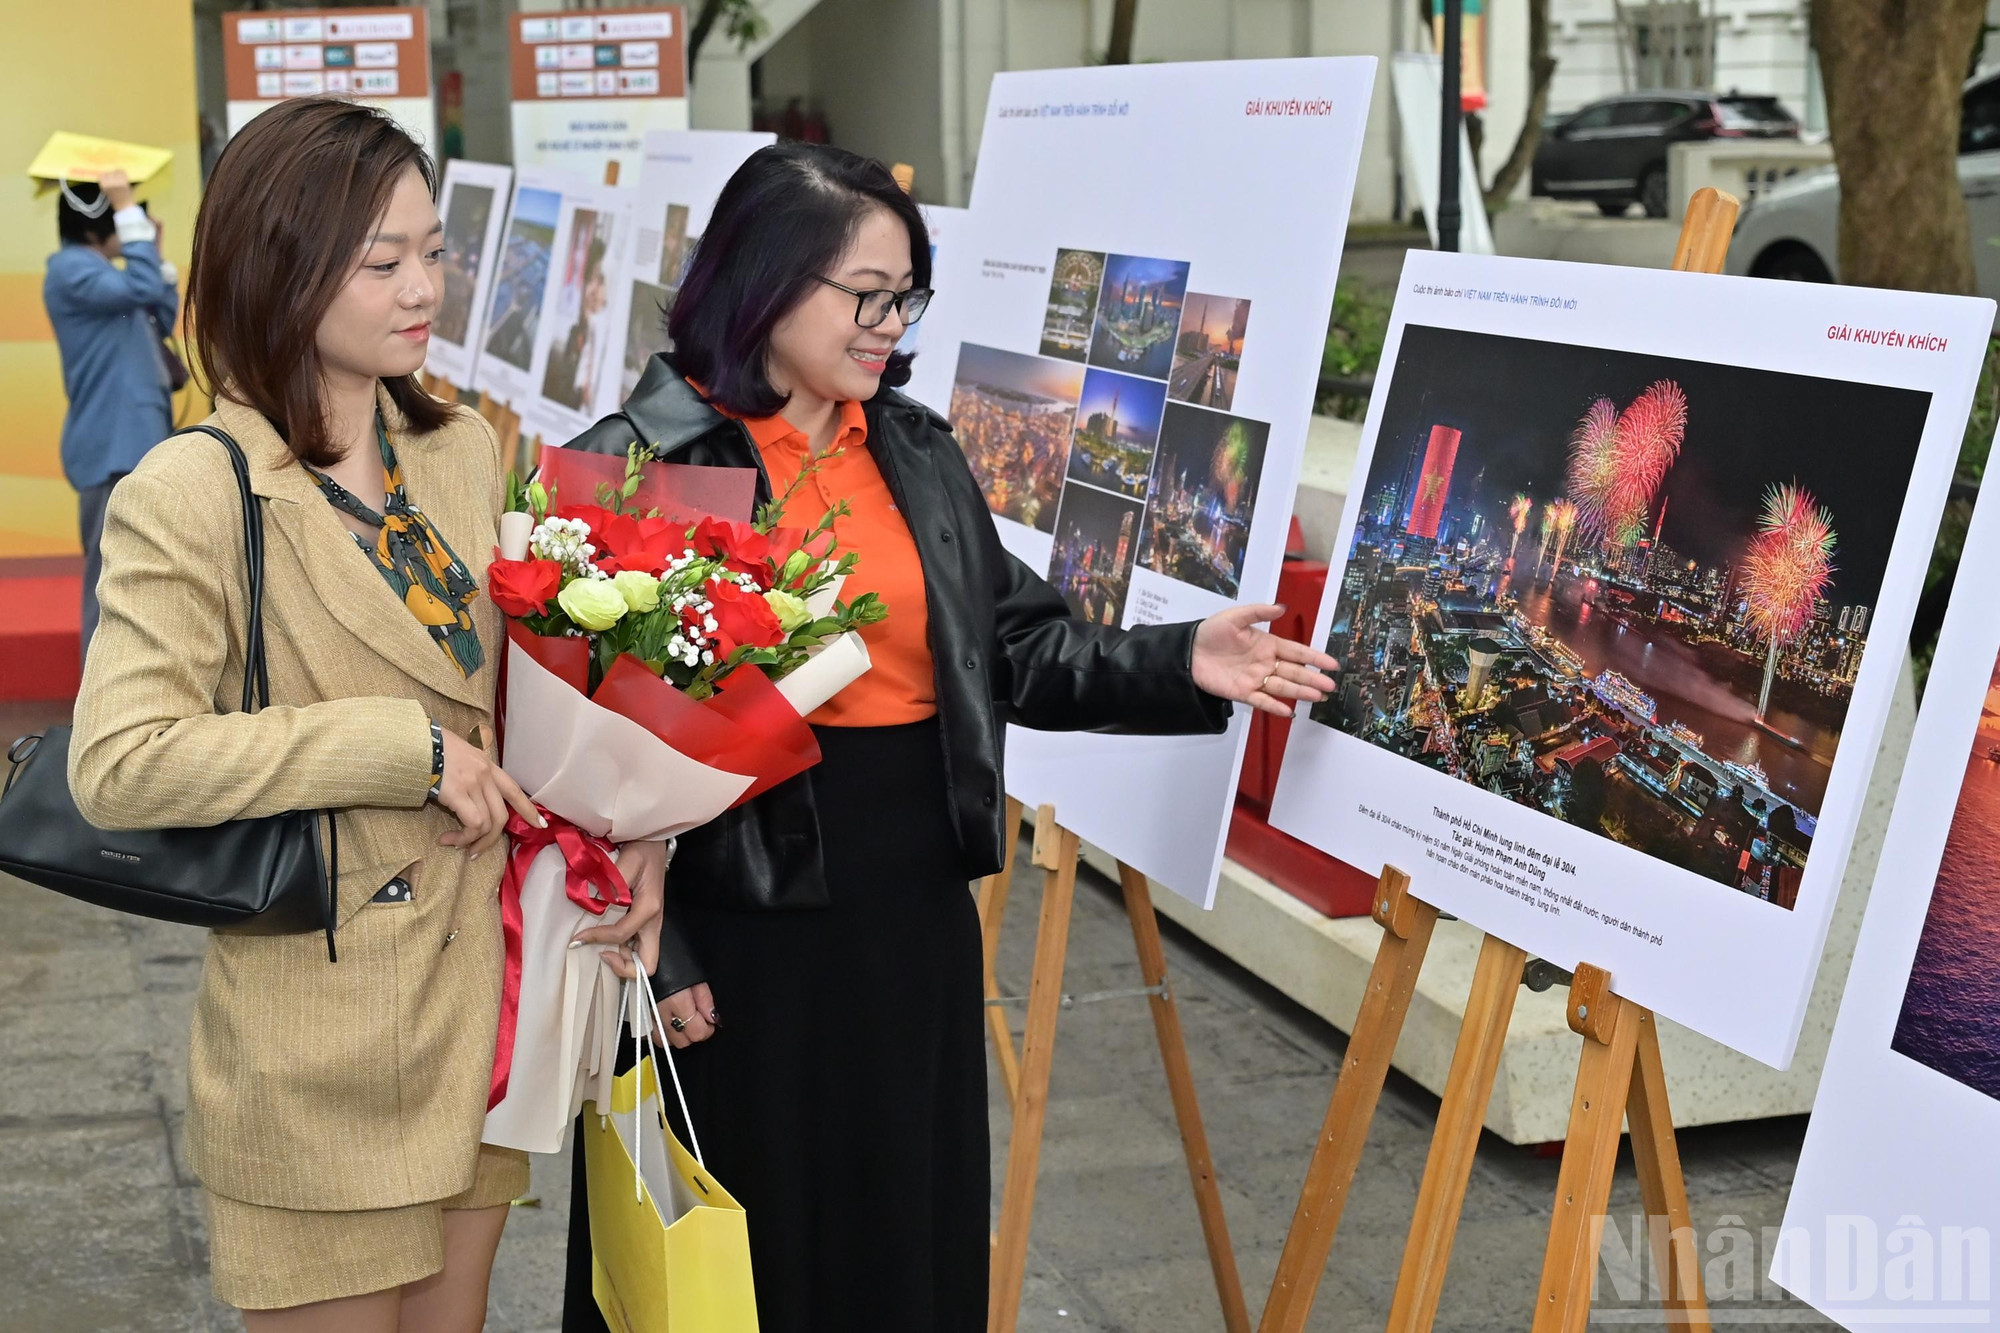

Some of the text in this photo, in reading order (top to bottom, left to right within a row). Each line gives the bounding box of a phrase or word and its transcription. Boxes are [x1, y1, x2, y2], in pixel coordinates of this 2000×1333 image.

[1246, 98, 1264, 116] GIẢI
[1303, 97, 1332, 116] KHÍCH
[1413, 284, 1427, 296] Cuộc
[1434, 286, 1443, 296] ảnh
[1444, 287, 1454, 297] báo
[1454, 288, 1463, 298] chí
[1464, 289, 1478, 300] VIỆT
[1478, 291, 1492, 301] NAM
[1493, 292, 1510, 303] TRÊN
[1510, 294, 1529, 305] HÀNH
[1530, 295, 1550, 307] TRÌNH
[1563, 299, 1578, 310] MỚI
[1827, 324, 1852, 341] GIẢI
[1907, 333, 1948, 352] KHÍCH
[1433, 806, 1577, 876] Thành phố Hồ Chí Minh lung linh đêm đại lễ 30/4.
[1452, 830, 1546, 881] Tác giả: Huỳnh Phạm Anh Dũng
[1381, 814, 1391, 825] 30/4
[1391, 820, 1402, 831] chào
[1402, 825, 1416, 839] mừng
[1422, 834, 1434, 845] niệm
[1434, 839, 1440, 848] 50
[1451, 846, 1464, 859] Ngày
[1474, 858, 1490, 872] phóng
[1490, 864, 1502, 876] hoàn
[1503, 870, 1515, 881] toàn
[1516, 875, 1529, 888] miền
[1529, 882, 1542, 896] nam,
[1543, 888, 1560, 903] thống
[1560, 896, 1572, 907] nhất
[1573, 900, 1583, 912] đất
[1583, 906, 1600, 920] nước,
[1601, 913, 1620, 927] người
[1620, 920, 1632, 933] dân
[1632, 926, 1650, 941] thành
[1650, 935, 1663, 946] phố
[1436, 853, 1447, 864] hoan
[1448, 859, 1459, 870] chào
[1480, 875, 1493, 886] pháo
[1494, 880, 1504, 891] hoa
[1504, 887, 1520, 899] hoành
[1537, 899, 1550, 913] lung
[1550, 905, 1561, 916] linh.
